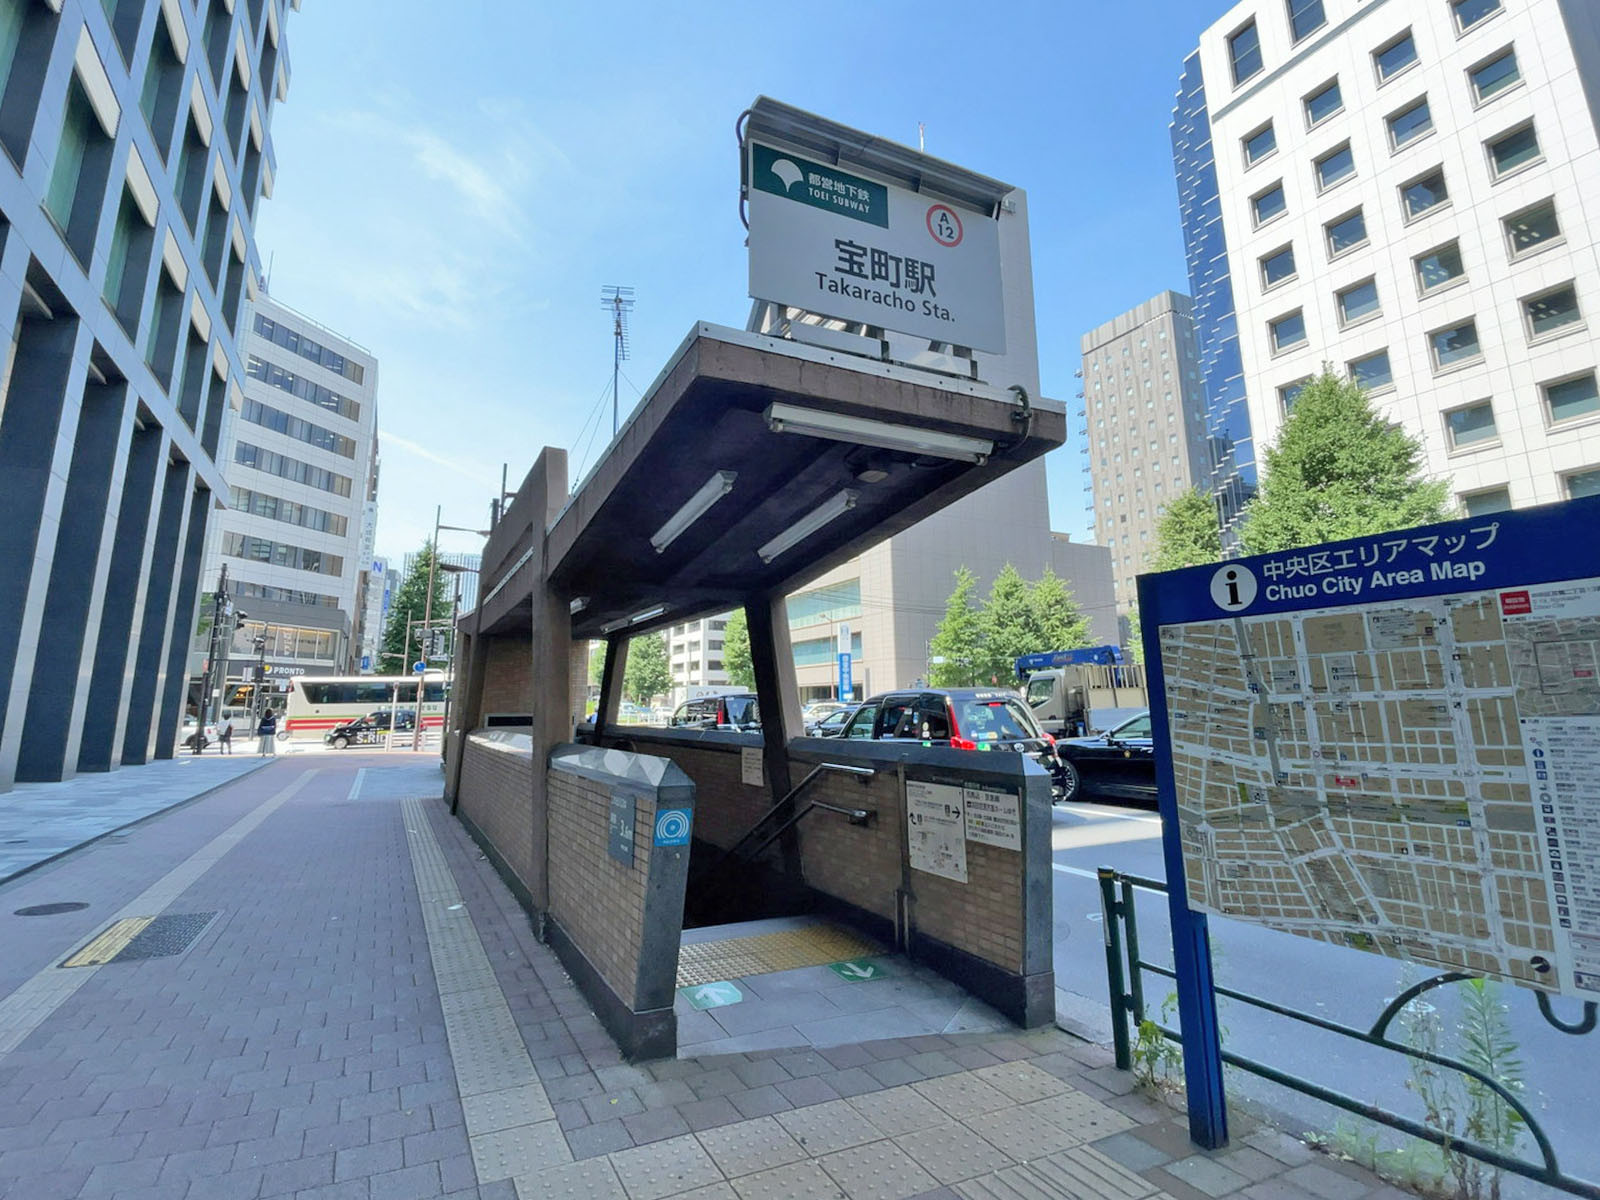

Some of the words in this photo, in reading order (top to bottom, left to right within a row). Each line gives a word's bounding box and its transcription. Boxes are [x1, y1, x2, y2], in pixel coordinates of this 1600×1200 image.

[808, 172, 870, 202] 都営地下鉄
[808, 187, 829, 201] TOEI
[832, 195, 870, 213] SUBWAY
[938, 224, 955, 240] 12
[940, 212, 950, 224] A
[834, 238, 937, 298] 宝町駅
[815, 271, 916, 312] Takaracho
[922, 300, 956, 322] Sta.
[1263, 522, 1500, 581] 中央区エリアマップ
[1265, 583, 1317, 601] Chuo
[1322, 576, 1363, 595] City
[1370, 570, 1424, 589] Area
[1430, 560, 1486, 581] Map
[273, 666, 305, 675] PRONTO
